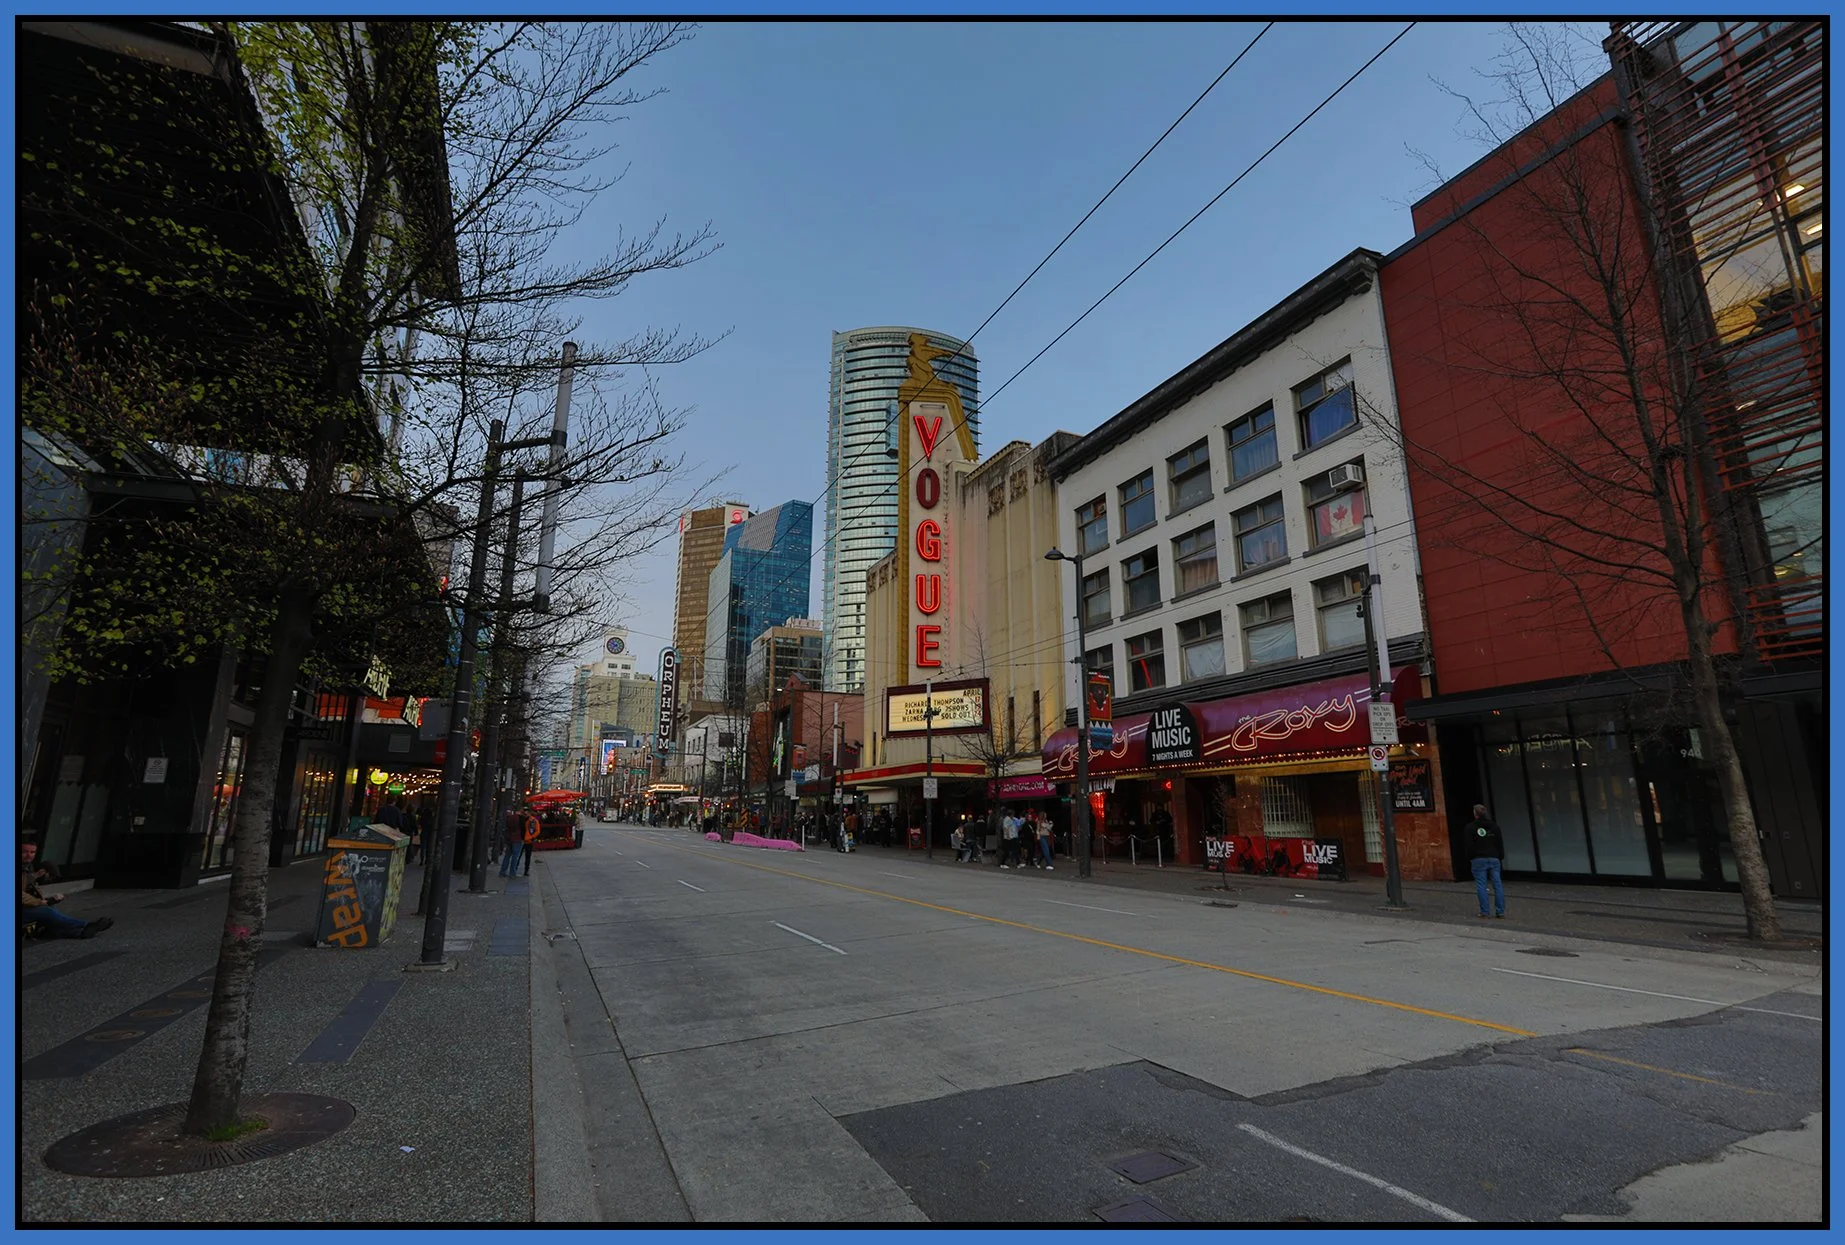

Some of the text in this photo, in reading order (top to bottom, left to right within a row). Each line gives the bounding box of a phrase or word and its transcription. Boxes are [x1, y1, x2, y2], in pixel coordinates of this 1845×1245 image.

[913, 415, 943, 668] VOGUE
[659, 655, 674, 749] ORPHEUM
[934, 698, 964, 706] THOMPSON
[941, 712, 957, 720] SOLD
[959, 711, 971, 719] OUT
[1154, 708, 1182, 729] LIVE
[1238, 714, 1252, 723] the
[1231, 693, 1357, 752] Roxy
[1151, 726, 1191, 749] MUSIC
[1156, 751, 1174, 761] NIGHTS
[1174, 751, 1178, 759] A
[1178, 749, 1193, 759] WEEK
[1395, 799, 1426, 808] UNTIL 4AM
[1206, 841, 1235, 853] LIVE
[1302, 844, 1338, 860] LIVE
[1304, 856, 1333, 865] MUSIC
